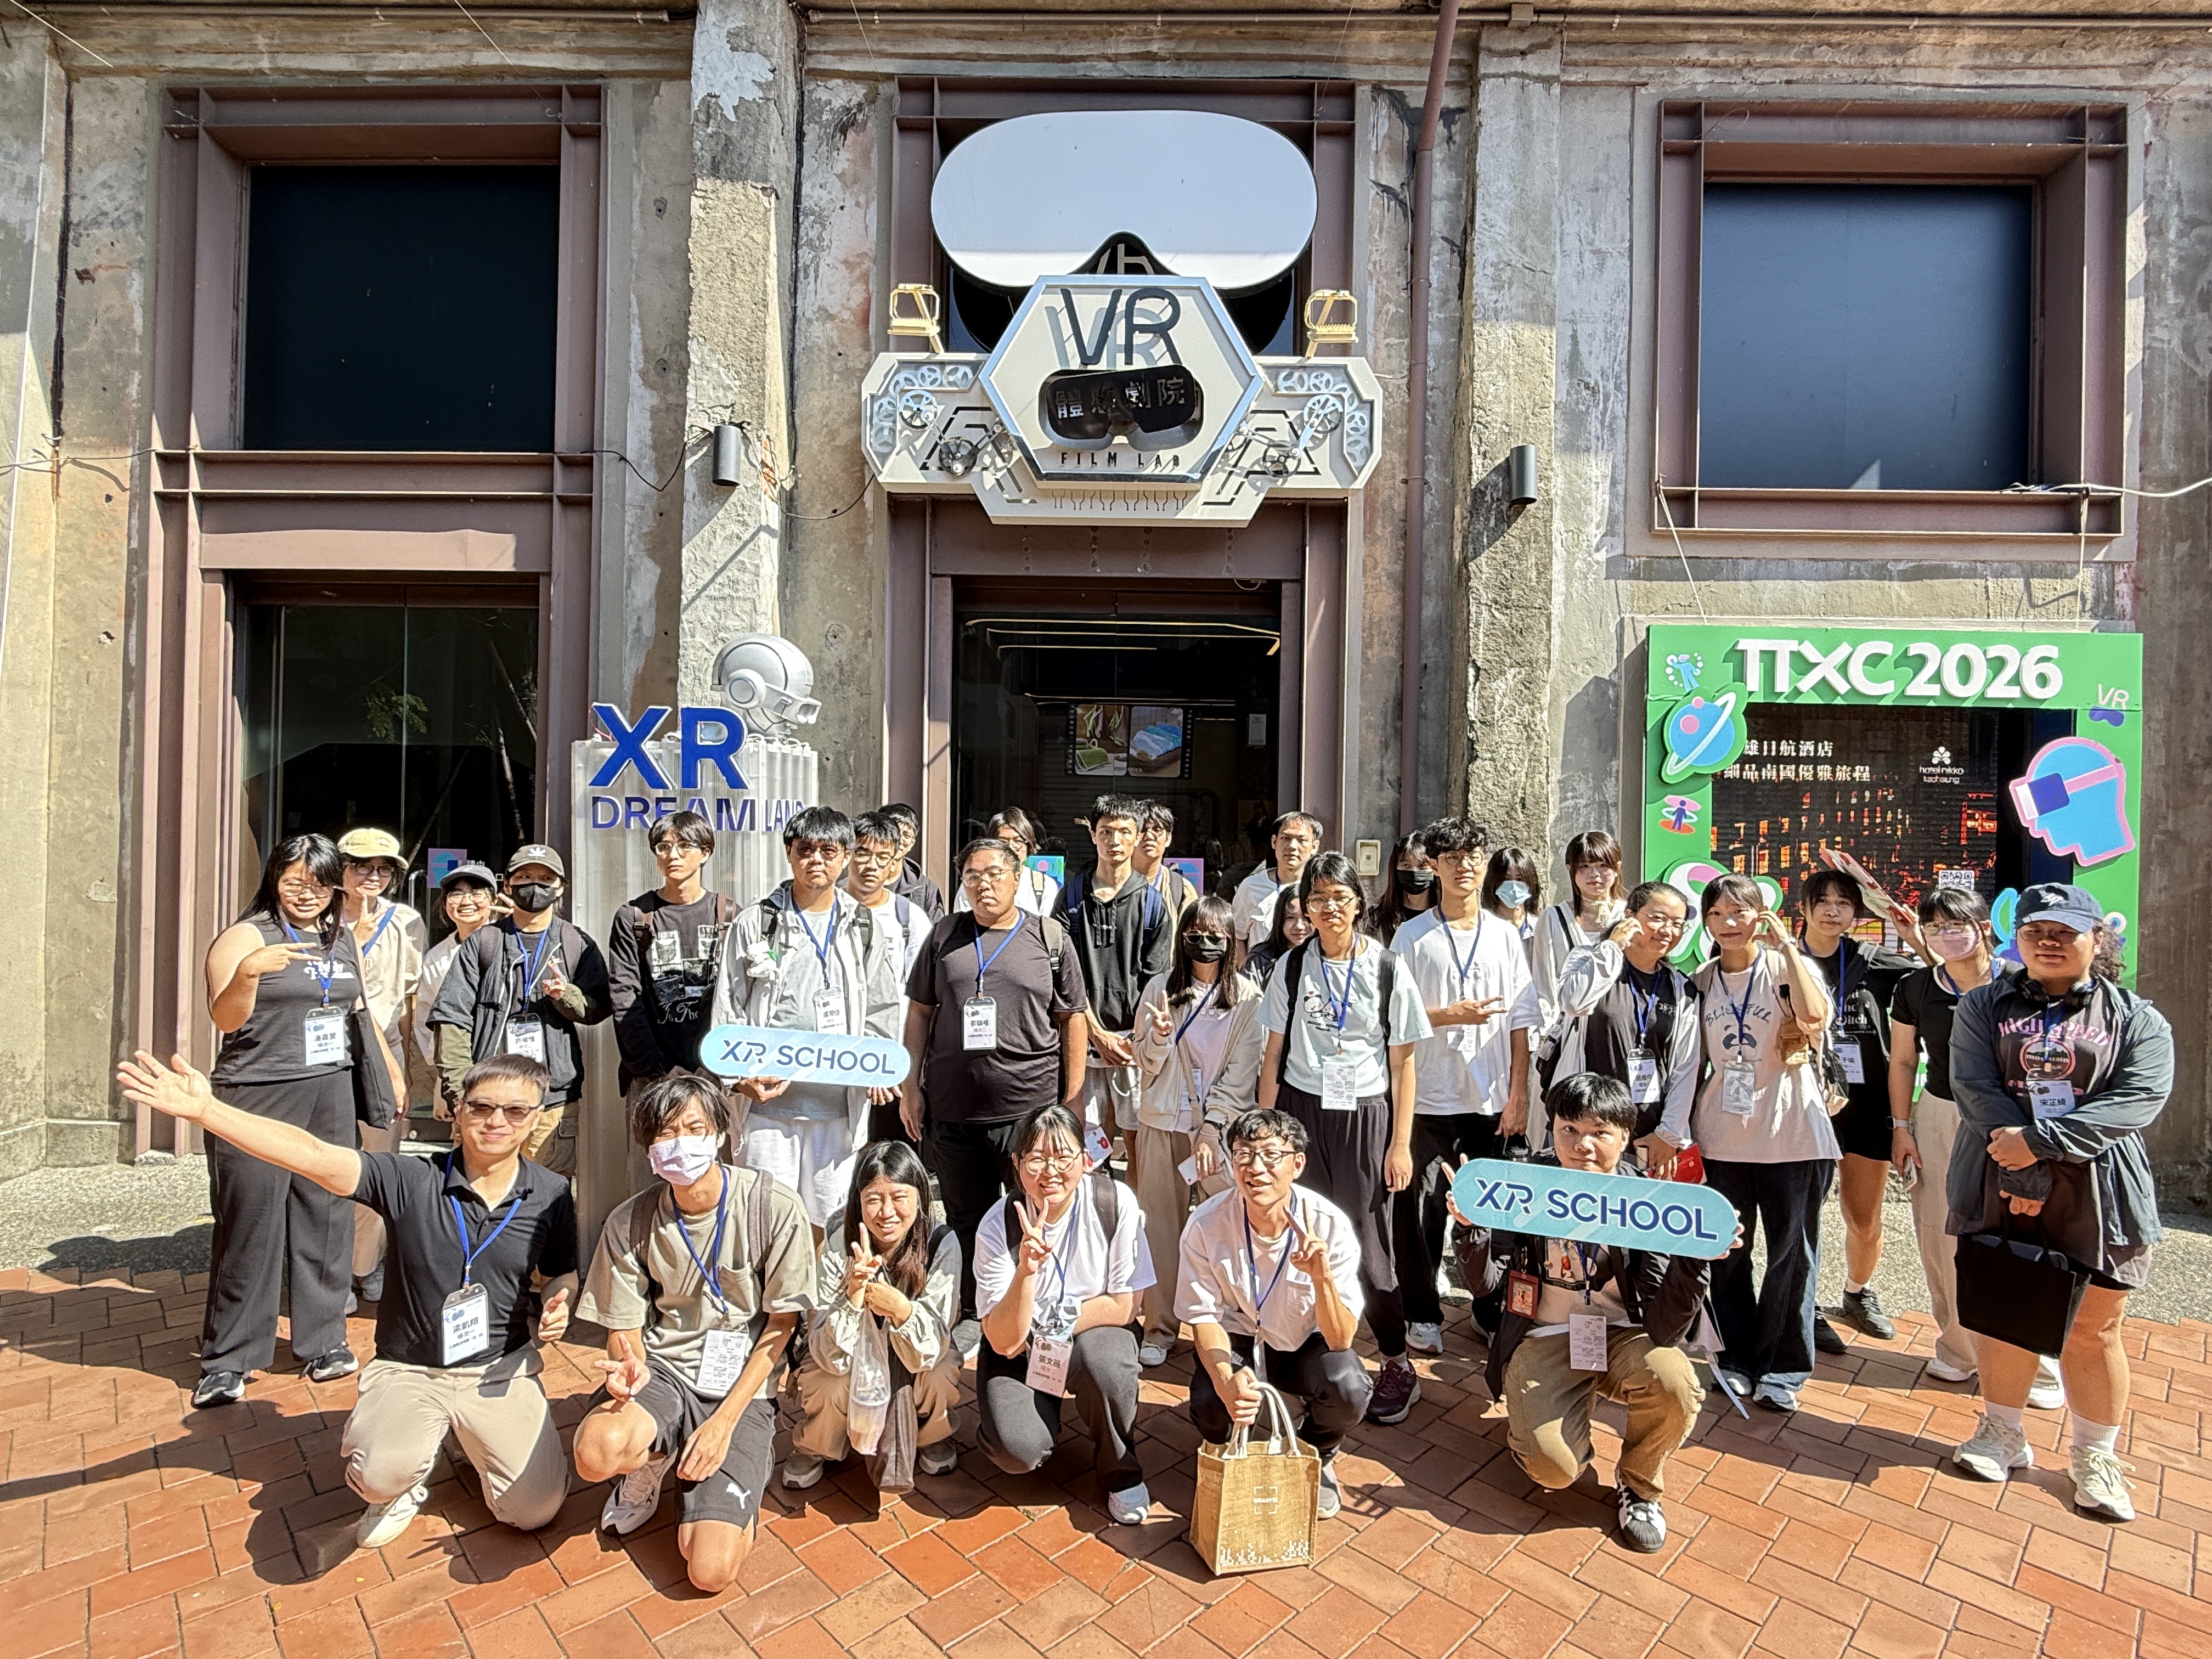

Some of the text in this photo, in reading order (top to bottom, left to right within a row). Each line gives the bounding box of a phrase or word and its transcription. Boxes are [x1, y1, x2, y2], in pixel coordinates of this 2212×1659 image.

[1060, 287, 1182, 365] VR
[1061, 452, 1180, 467] FILM LAB
[1904, 643, 2064, 699] 2026
[2098, 684, 2129, 710] VR
[588, 702, 751, 790] XR
[1743, 740, 1833, 757] 雄日航酒店
[591, 795, 756, 832] DREAM
[719, 1039, 896, 1074] XR SCHOOL
[2026, 1054, 2070, 1063] motain
[1475, 1177, 1718, 1241] XR SCHOOL
